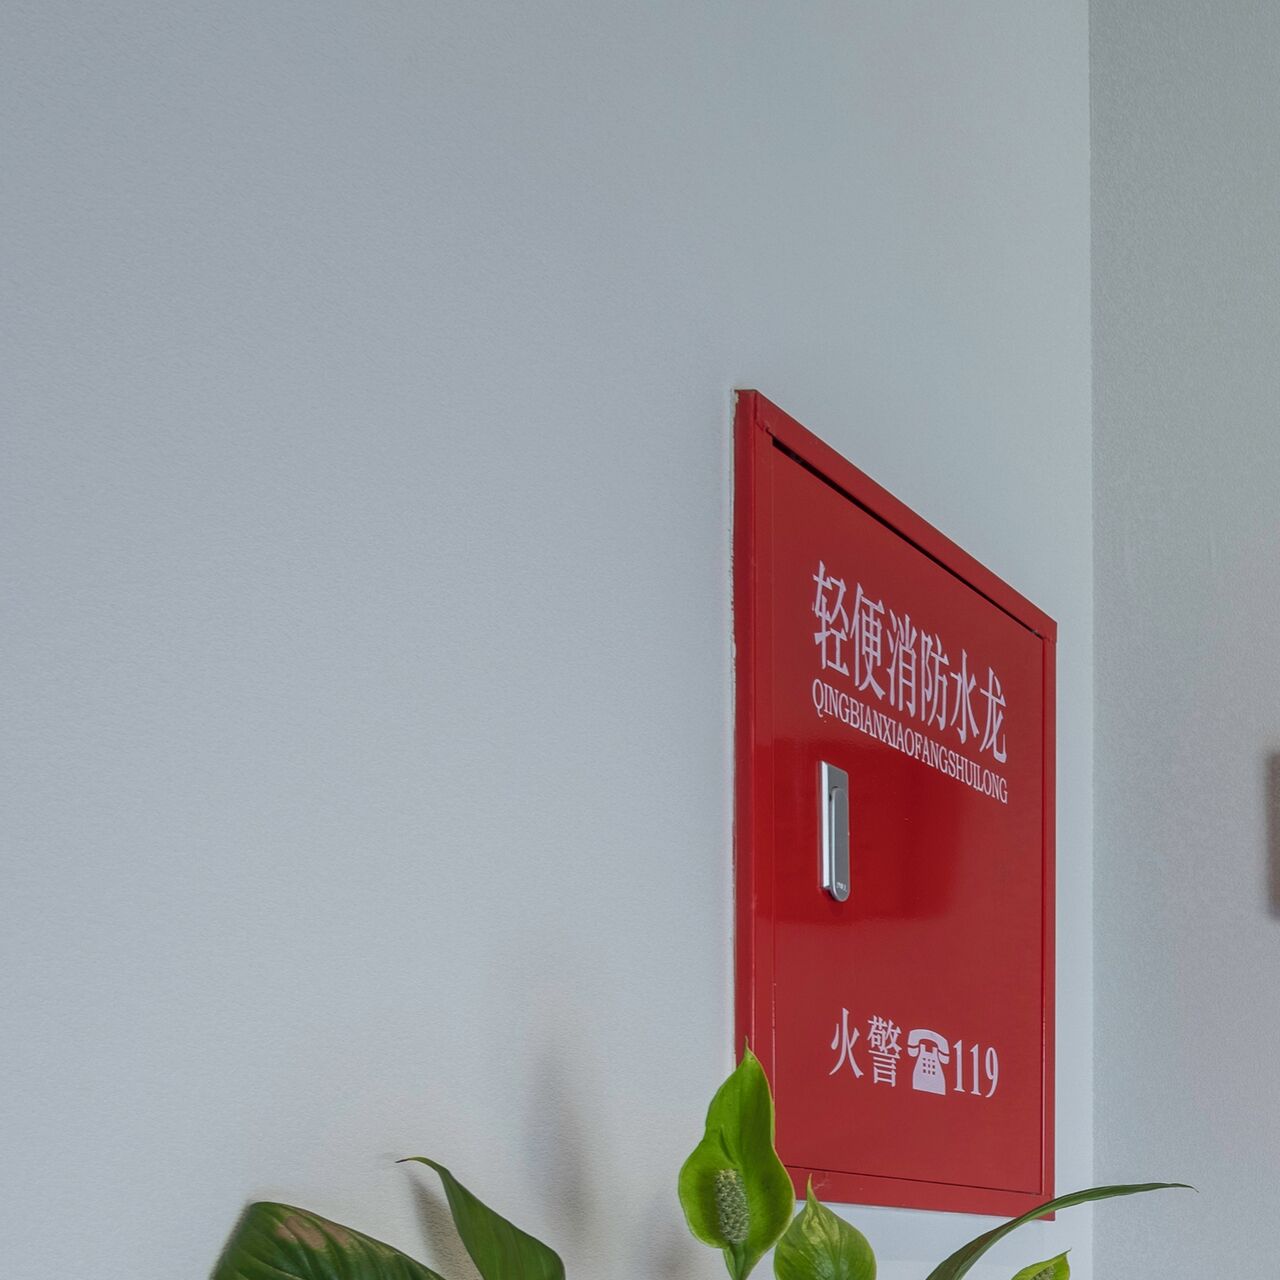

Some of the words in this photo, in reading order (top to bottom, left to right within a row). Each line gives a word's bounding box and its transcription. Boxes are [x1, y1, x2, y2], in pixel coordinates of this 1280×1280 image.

[812, 560, 1007, 764] 轻便消防水龙
[812, 679, 1008, 804] QINGBIANXIAOFANGSHUILONG
[829, 1007, 903, 1088] 火警
[953, 1039, 999, 1098] 119
